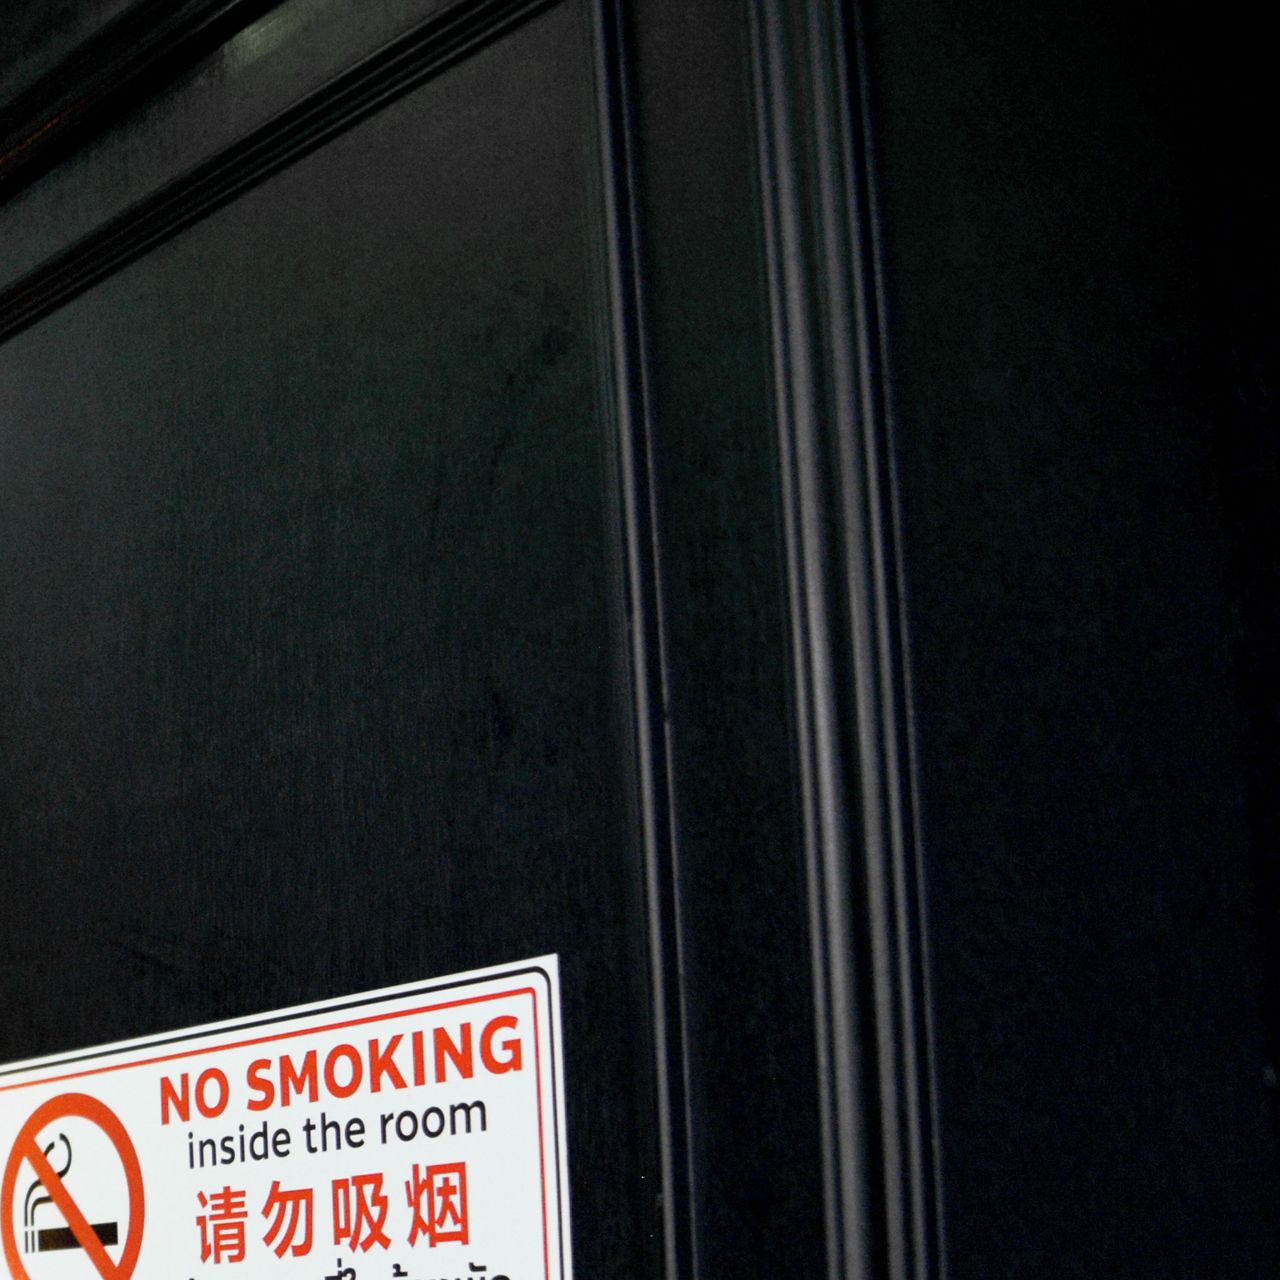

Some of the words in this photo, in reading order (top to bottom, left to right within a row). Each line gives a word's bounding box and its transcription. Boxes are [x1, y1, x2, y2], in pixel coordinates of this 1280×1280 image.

[159, 1068, 230, 1125] NO
[246, 1014, 524, 1112] SMOKING
[187, 1121, 307, 1169] inside
[303, 1111, 366, 1154] the
[380, 1099, 488, 1145] room
[196, 1161, 472, 1265] 请勿吸烟
